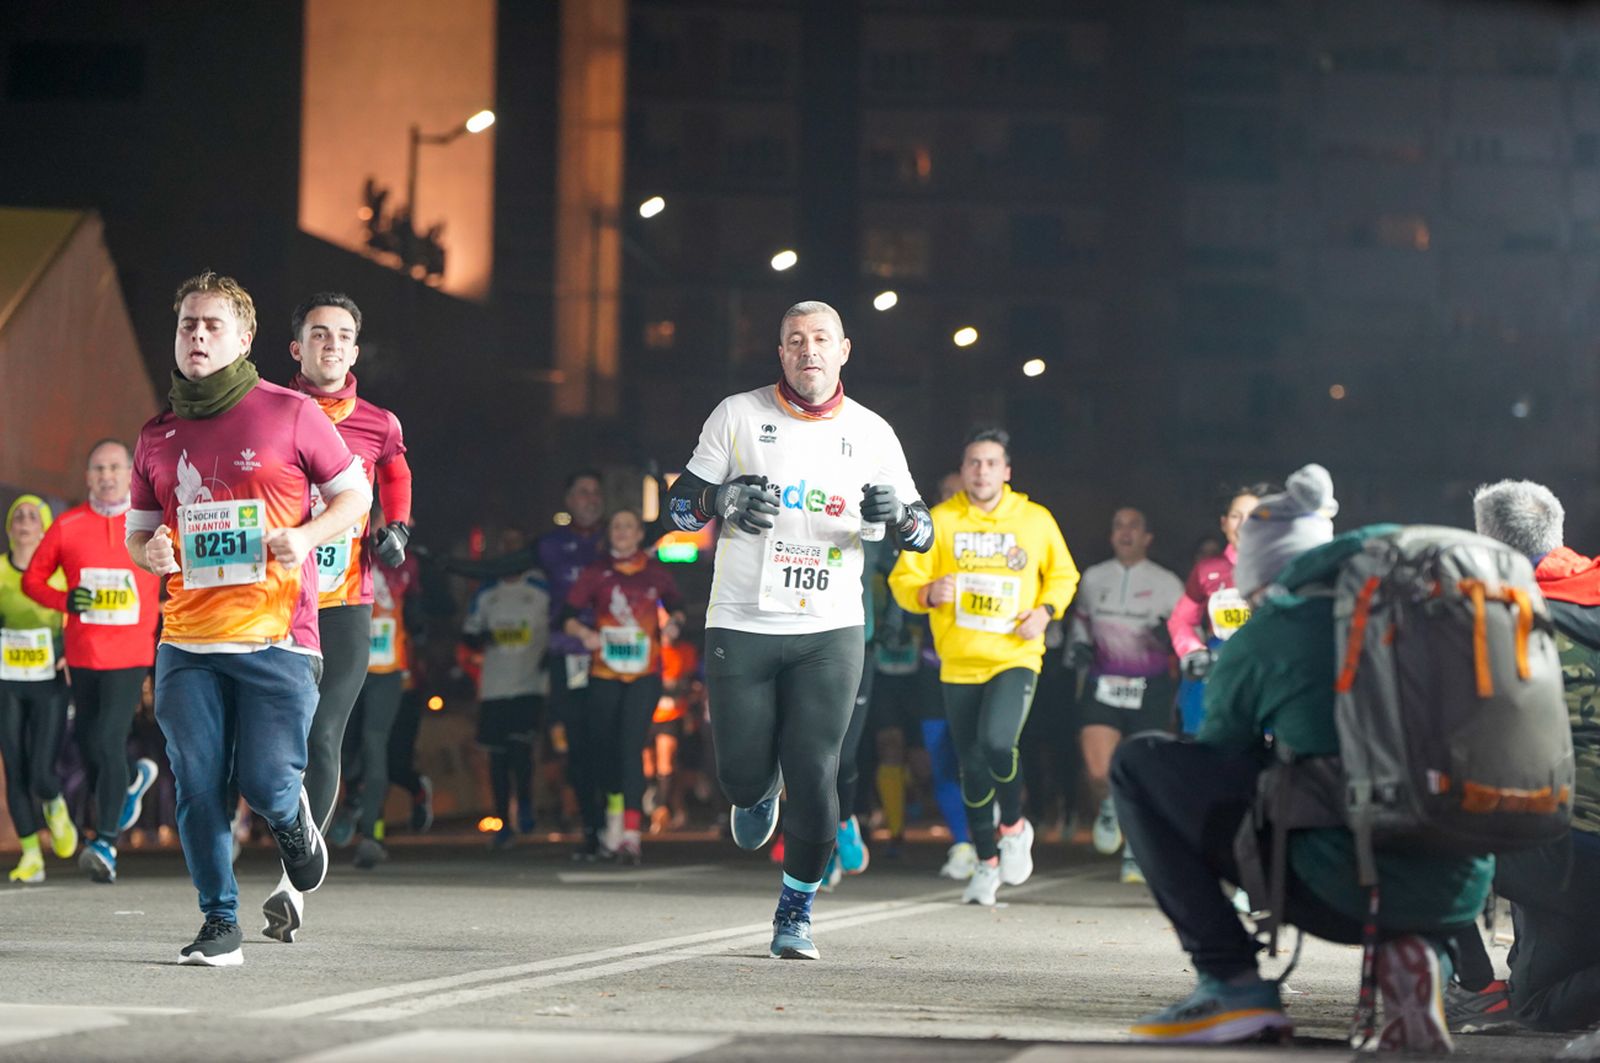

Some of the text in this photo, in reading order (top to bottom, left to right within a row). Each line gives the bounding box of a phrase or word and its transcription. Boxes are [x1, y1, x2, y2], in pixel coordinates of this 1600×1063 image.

[194, 511, 218, 521] NOCHE
[187, 522, 200, 532] SAN
[195, 531, 248, 558] 8251
[785, 546, 821, 557] NOCHE DE
[774, 554, 790, 564] SAN
[783, 566, 829, 591] 1136
[96, 590, 128, 605] 5170
[971, 593, 1002, 612] 7142
